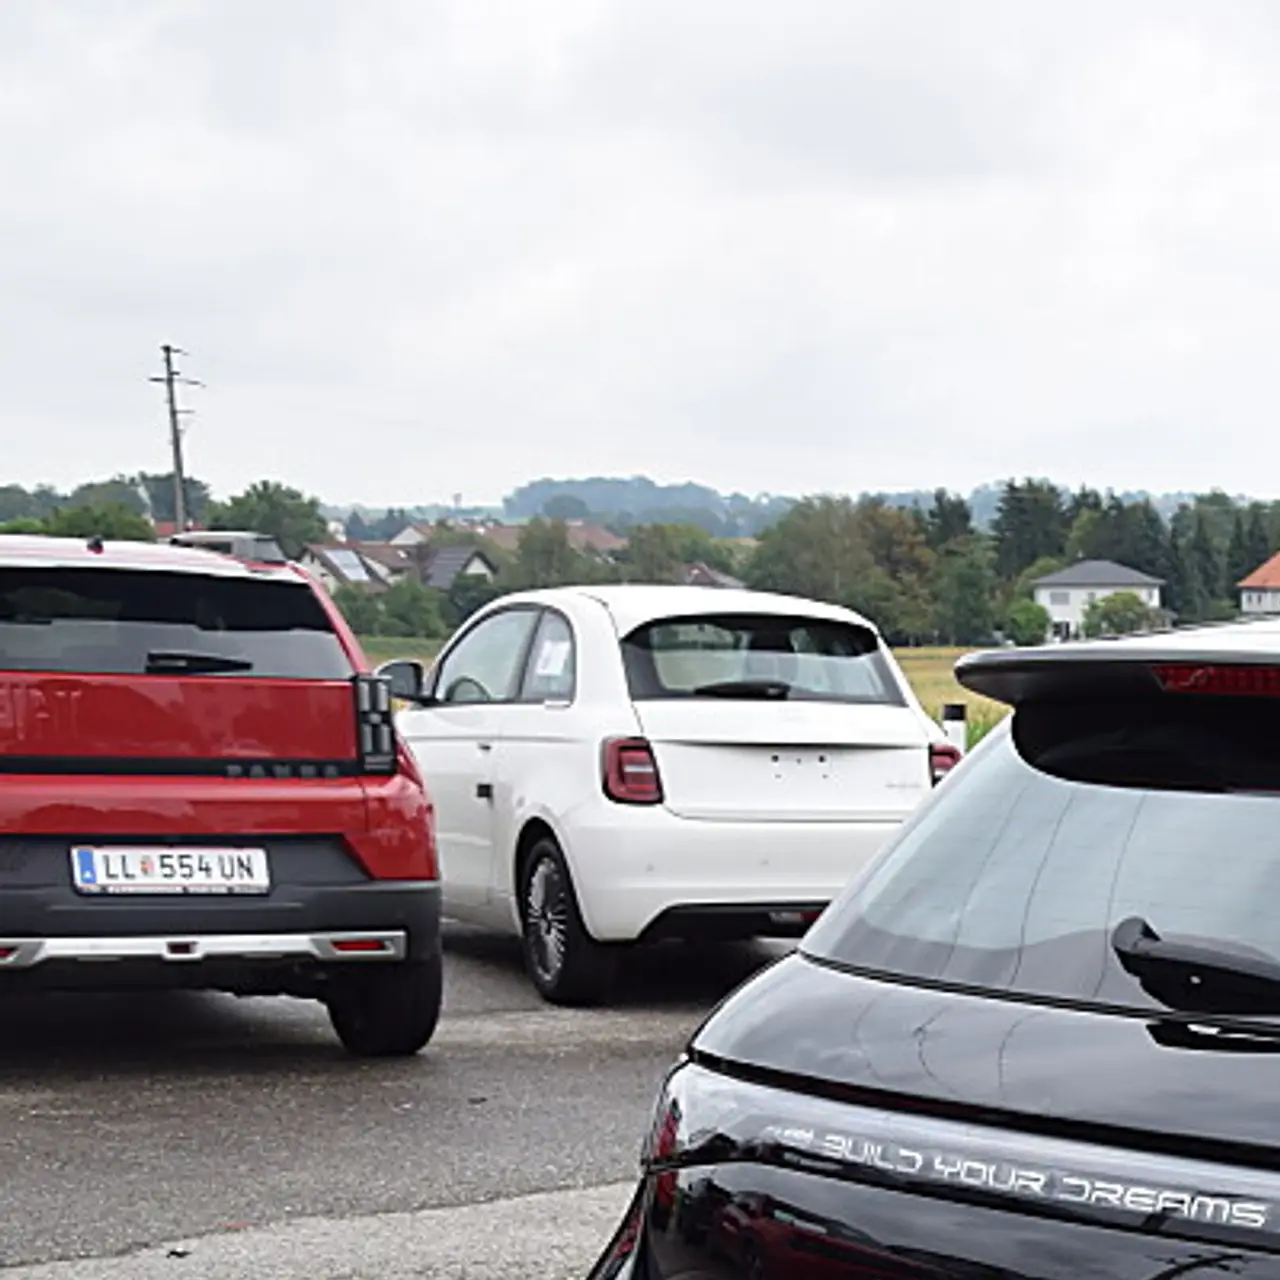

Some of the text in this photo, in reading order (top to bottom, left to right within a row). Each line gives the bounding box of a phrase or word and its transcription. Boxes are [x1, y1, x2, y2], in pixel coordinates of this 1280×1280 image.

[103, 854, 254, 879] LL 554 UN
[823, 1133, 1268, 1230] BUILD YOUR DREAMS
